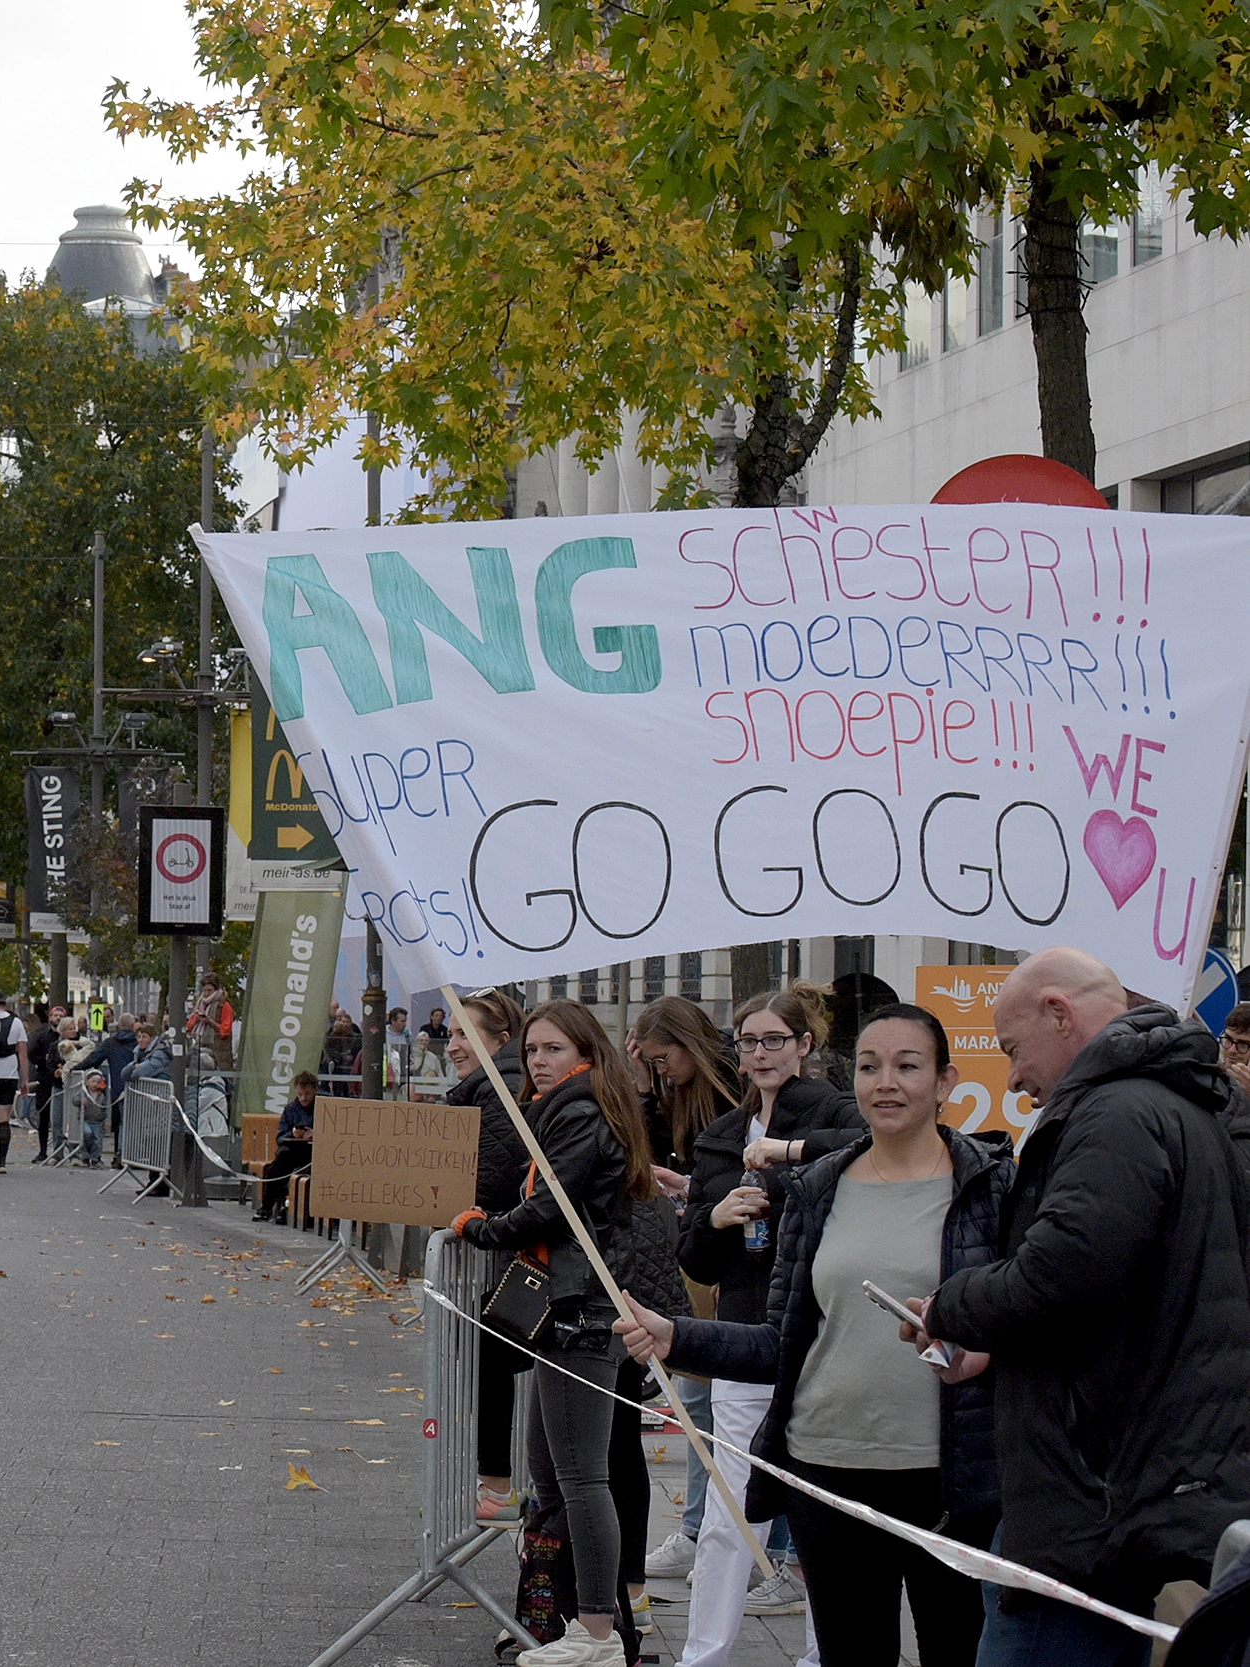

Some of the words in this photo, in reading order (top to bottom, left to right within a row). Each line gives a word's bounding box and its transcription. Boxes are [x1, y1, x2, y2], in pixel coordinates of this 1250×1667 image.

[263, 536, 662, 722] ANG
[1061, 724, 1166, 818] WE
[41, 775, 65, 849] STING
[169, 903, 183, 911] Stap
[262, 867, 331, 879] meir-as.be
[469, 799, 672, 953] GO
[714, 785, 900, 917] GO
[919, 791, 1070, 926] GO
[265, 914, 317, 1115] McDonald's
[323, 1102, 387, 1137] NIET
[393, 1105, 471, 1141] DENKEN
[948, 1081, 1046, 1157] 29
